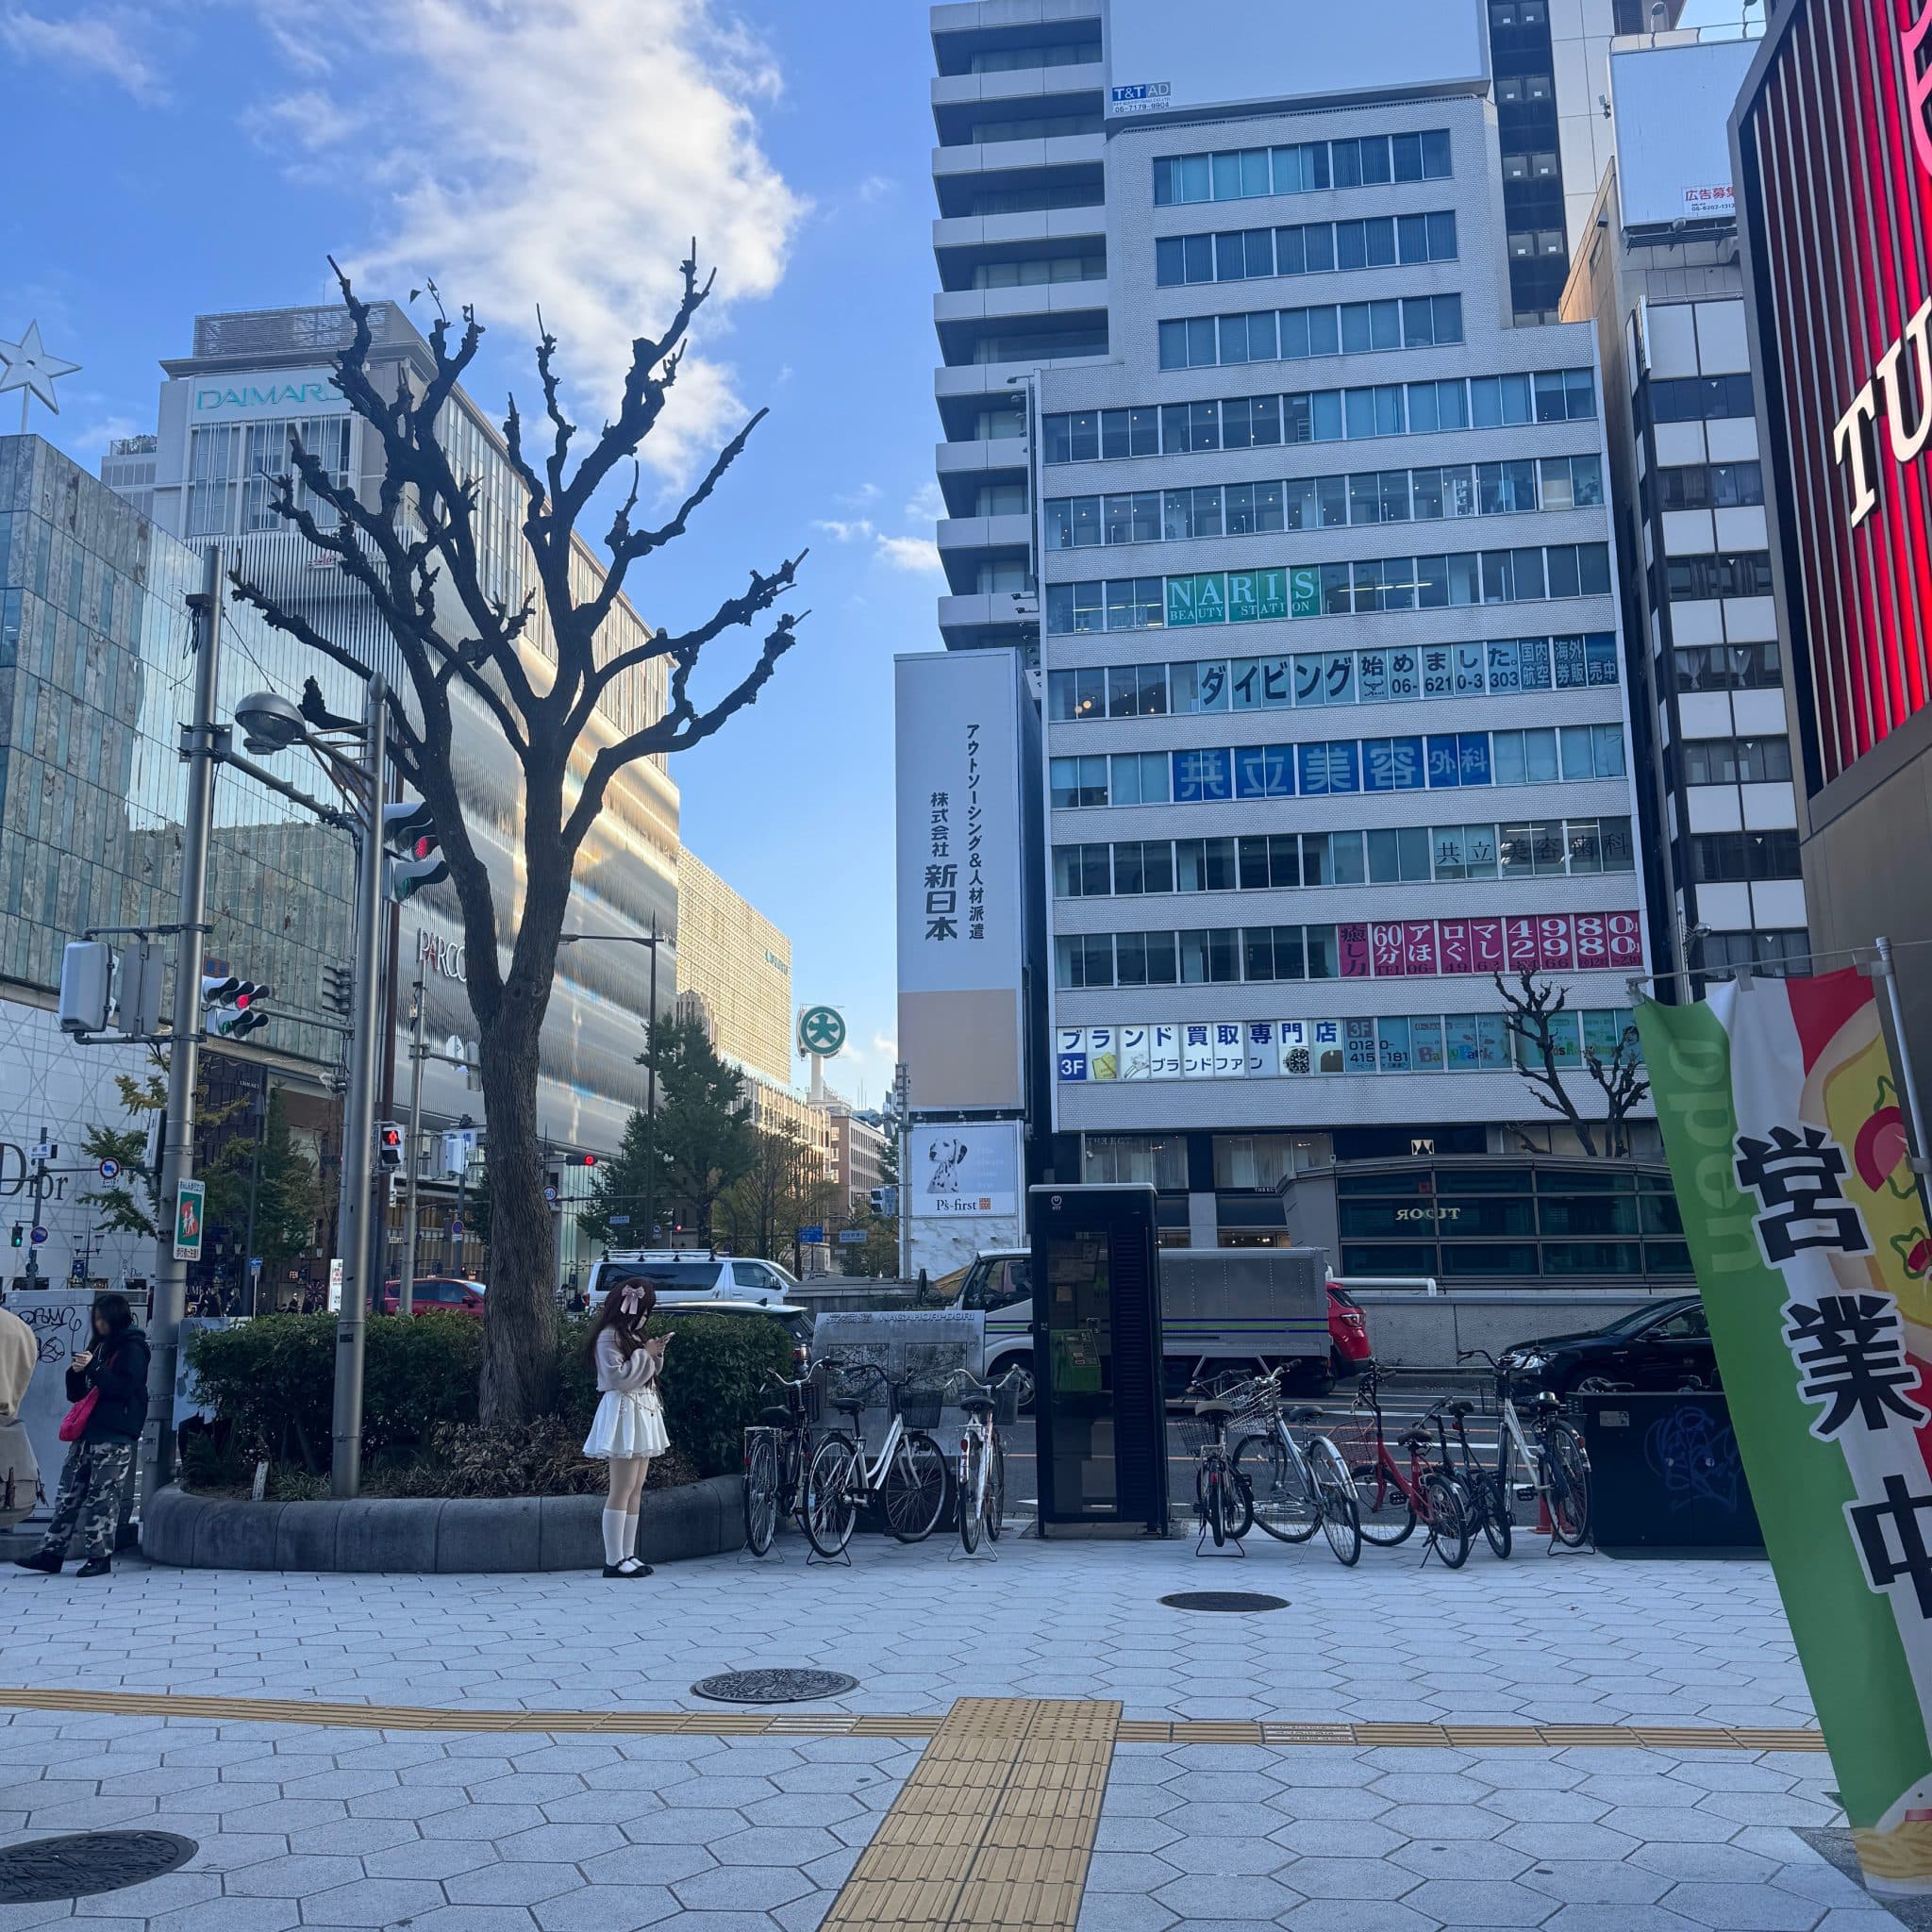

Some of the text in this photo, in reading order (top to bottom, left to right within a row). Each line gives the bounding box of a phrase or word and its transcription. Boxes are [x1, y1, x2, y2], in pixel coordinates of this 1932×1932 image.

[1113, 83, 1170, 100] T&T AD
[1170, 571, 1315, 608] NARIS
[1170, 601, 1310, 621] BEAUTY STATION
[1201, 659, 1352, 706] ダイビング
[1391, 671, 1518, 694] 06-6210-3303
[1523, 660, 1616, 686] 航空券販売中
[1181, 745, 1488, 798] 共立美容外科
[966, 724, 984, 941] アウトソーシング&人材派遣
[1062, 1021, 1338, 1051] ブランド買取専門店
[1350, 1023, 1369, 1037] 3F
[1061, 1058, 1084, 1075] 3F
[1152, 1056, 1263, 1073] ブランドファン
[0, 1142, 69, 1201] Dior
[1737, 1125, 1932, 1619] 営業中
